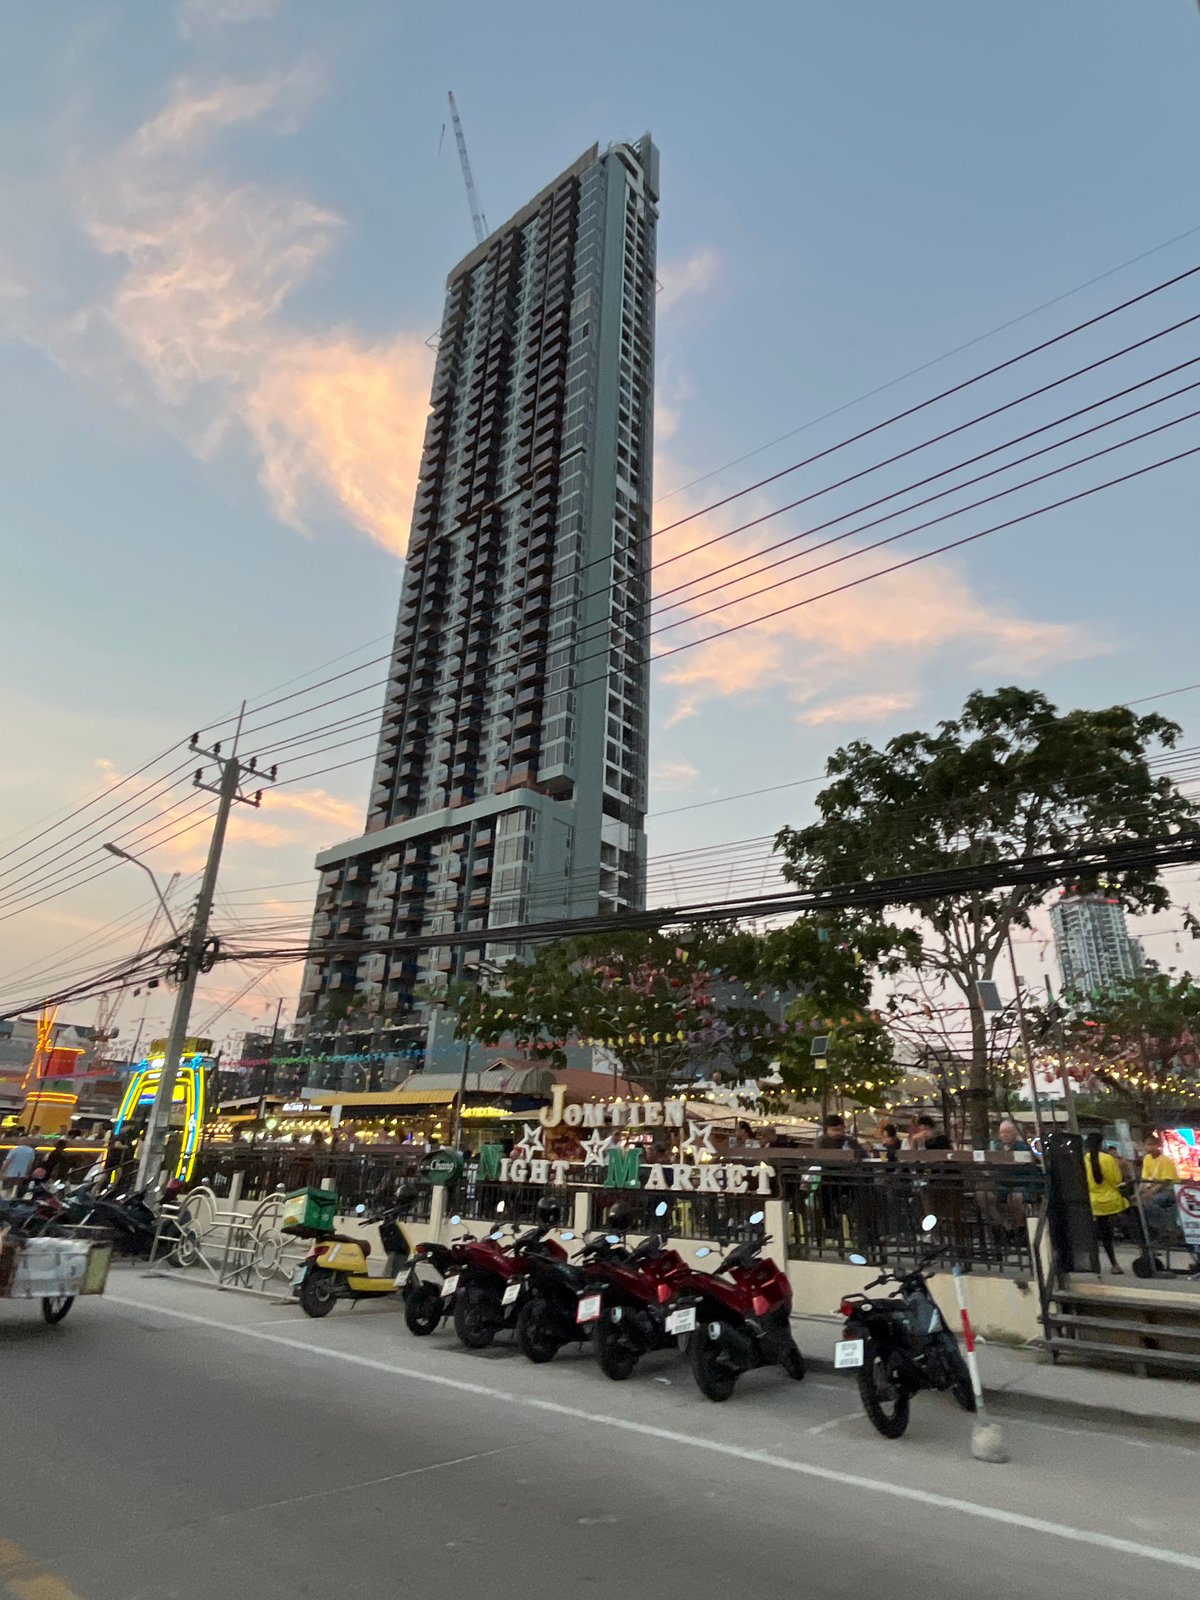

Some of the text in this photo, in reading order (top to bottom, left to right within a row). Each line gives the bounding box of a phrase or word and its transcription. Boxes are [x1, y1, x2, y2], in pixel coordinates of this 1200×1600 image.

[539, 1084, 686, 1128] JOMTIEN
[430, 1159, 454, 1172] Chang
[476, 1144, 776, 1195] NIGHT MARKET
